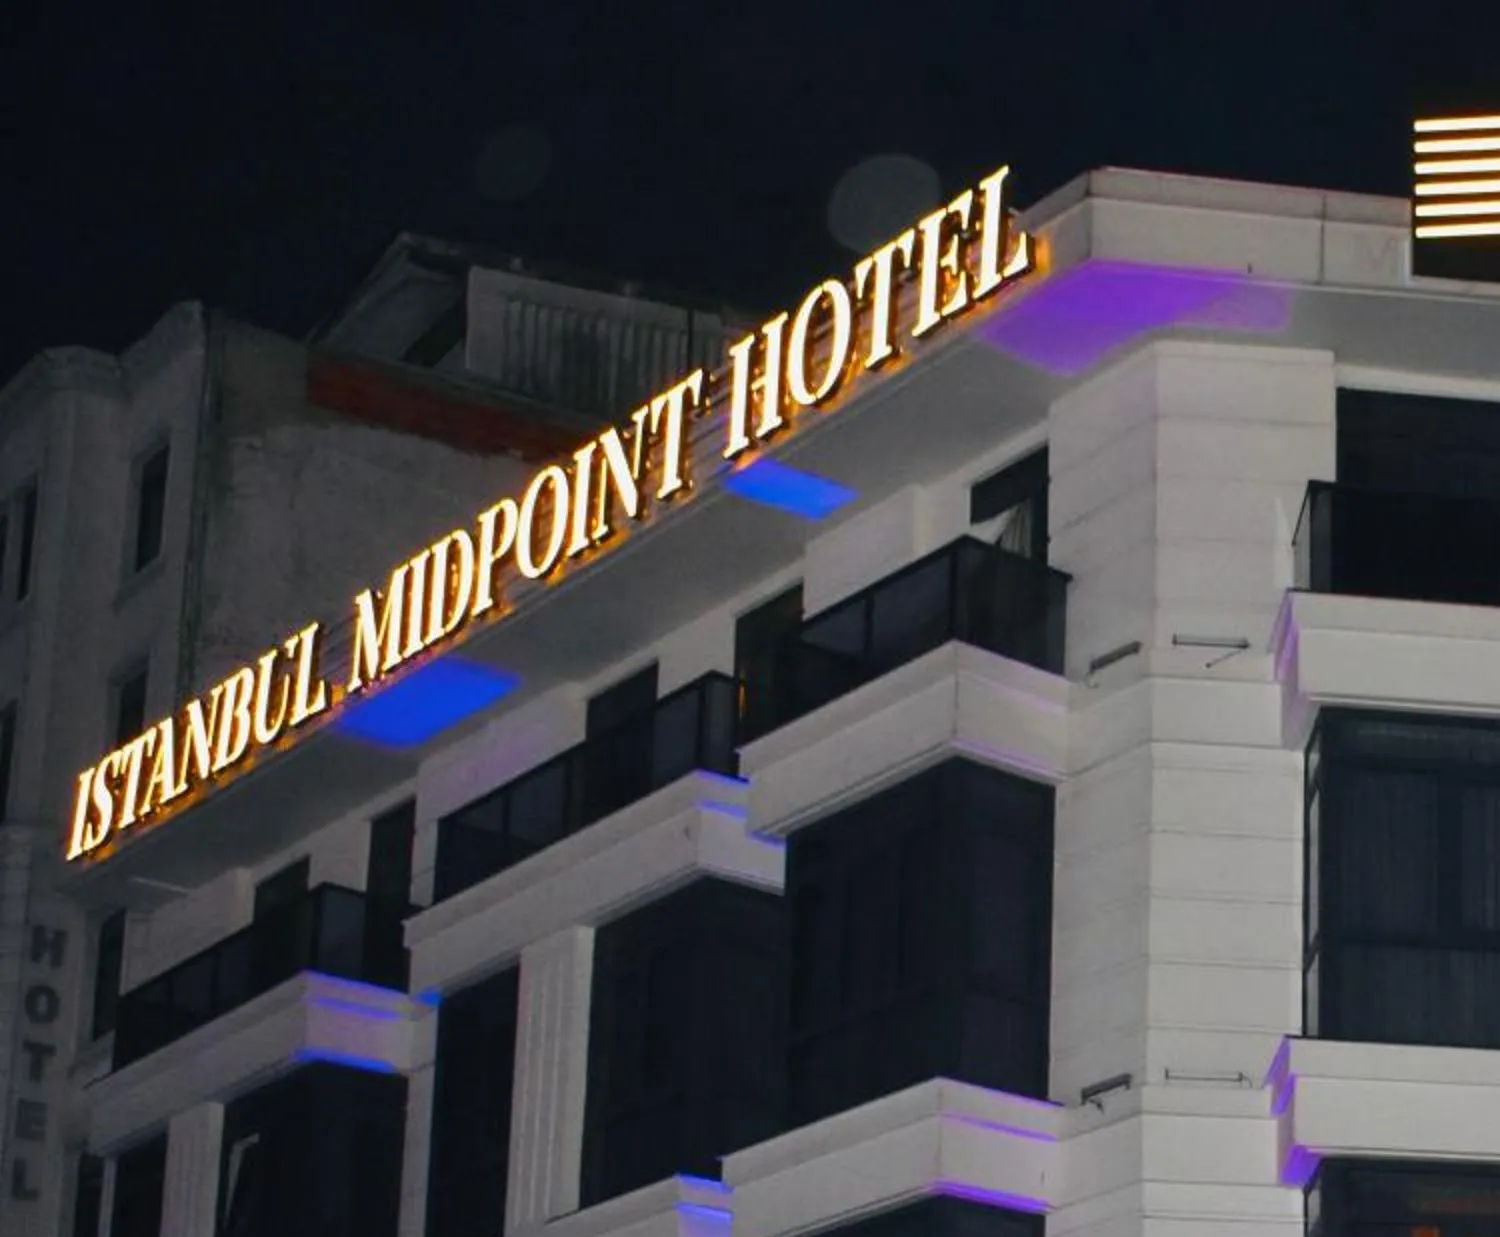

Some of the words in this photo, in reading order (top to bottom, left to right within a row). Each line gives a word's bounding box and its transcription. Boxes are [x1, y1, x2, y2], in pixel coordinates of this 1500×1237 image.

[65, 622, 327, 862] ISTANBUL
[346, 367, 704, 694] MIDPOINT
[722, 164, 1030, 460] HOTEL
[11, 924, 68, 1201] HOTEL
